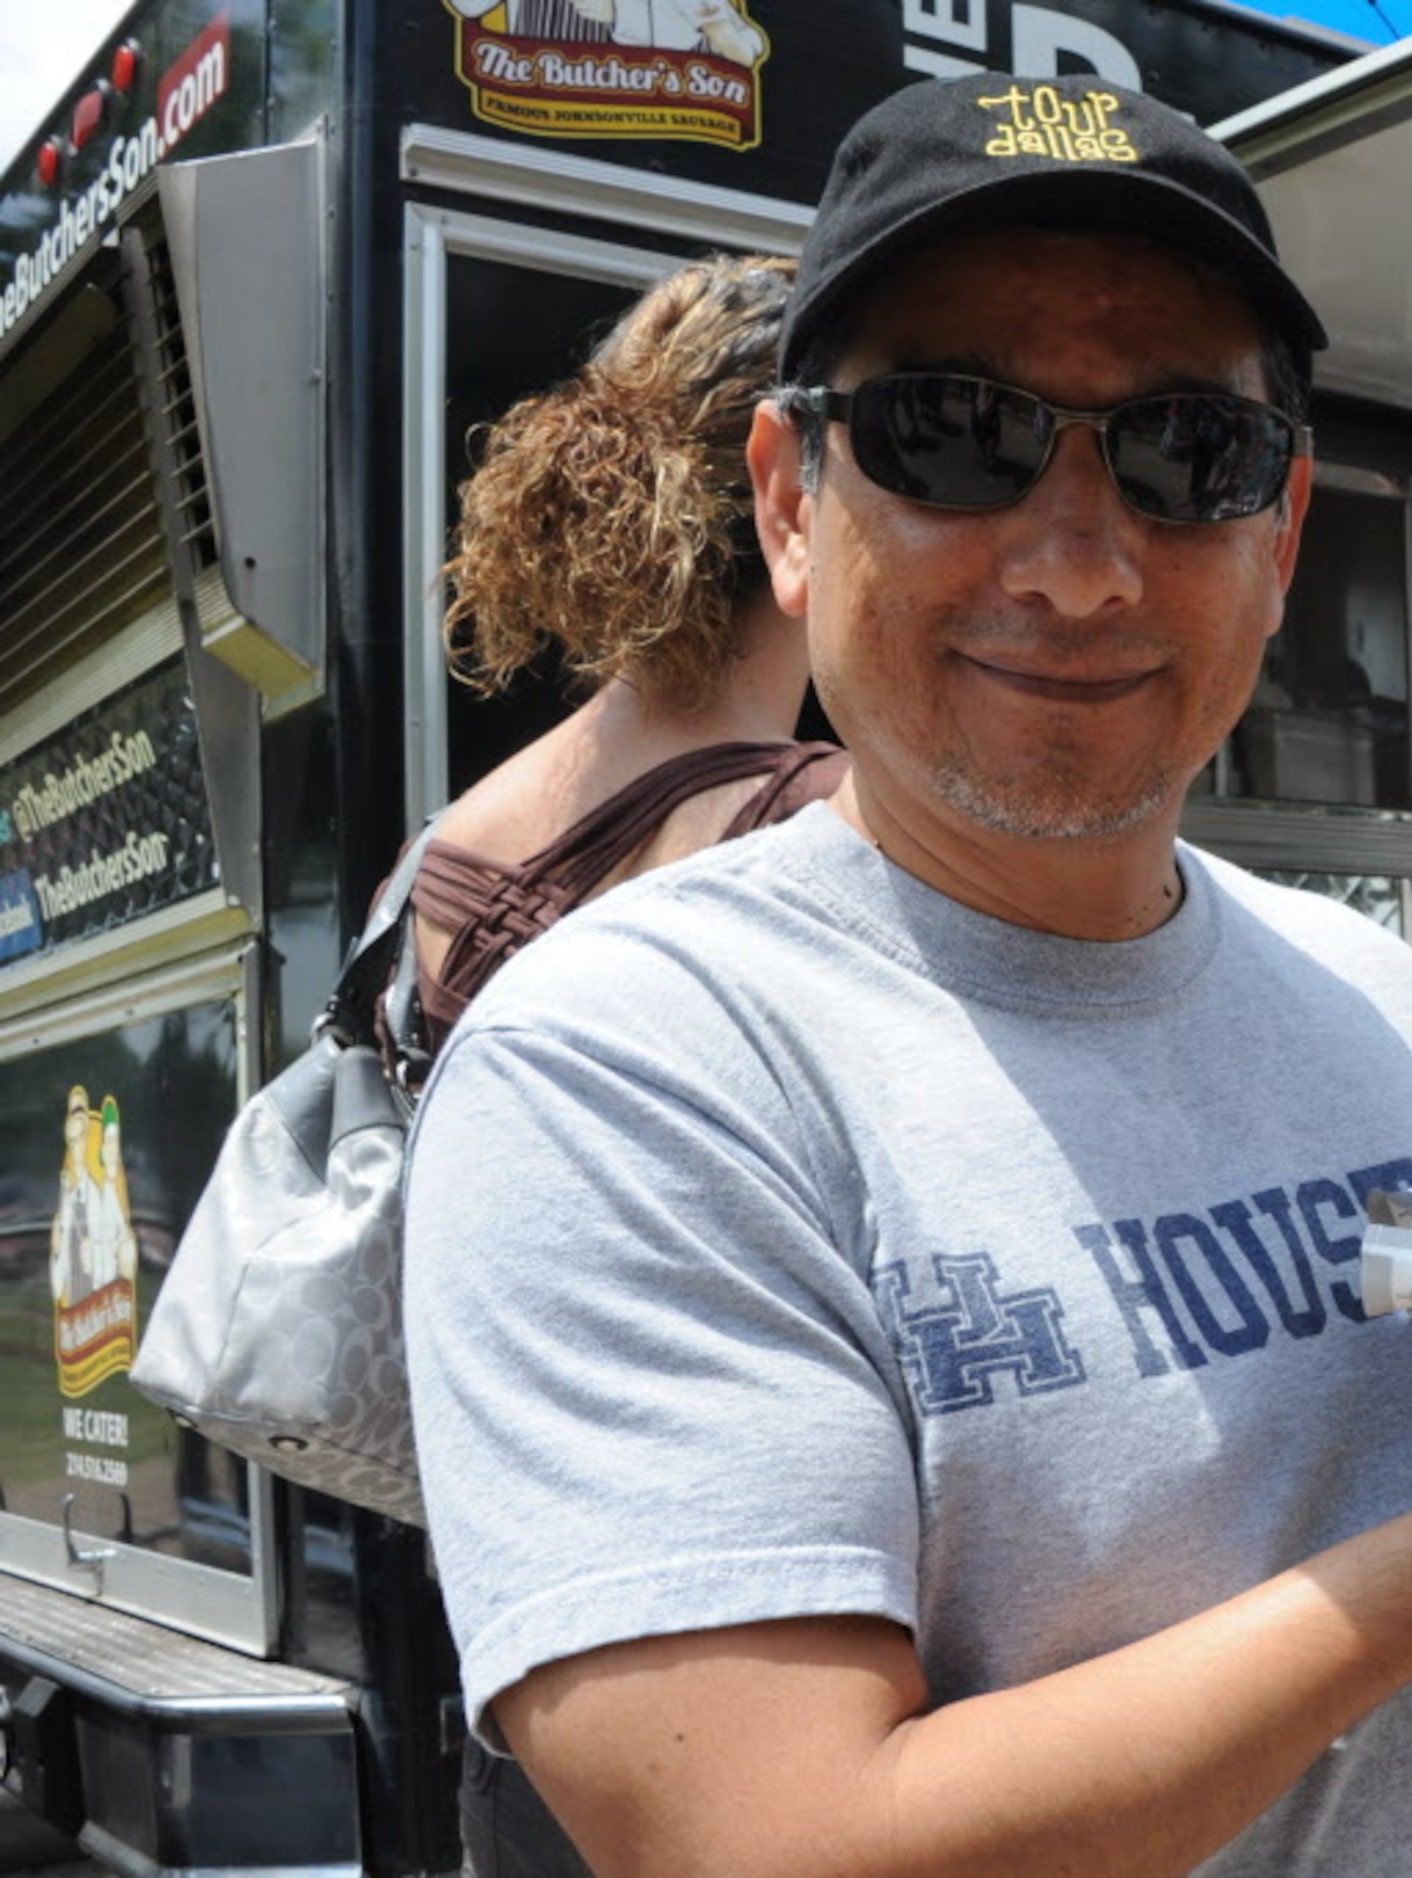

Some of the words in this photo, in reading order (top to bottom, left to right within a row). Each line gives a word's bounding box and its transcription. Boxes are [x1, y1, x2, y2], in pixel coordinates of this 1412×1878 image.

[476, 43, 534, 82] The
[538, 52, 682, 92] Butcher's
[688, 65, 747, 103] Son
[484, 97, 551, 120] FAMOUS
[554, 109, 668, 125] JOHNSONVILLE
[671, 112, 738, 133] SAUSAGE
[985, 124, 1139, 162] dallas
[62, 1406, 83, 1441] WE
